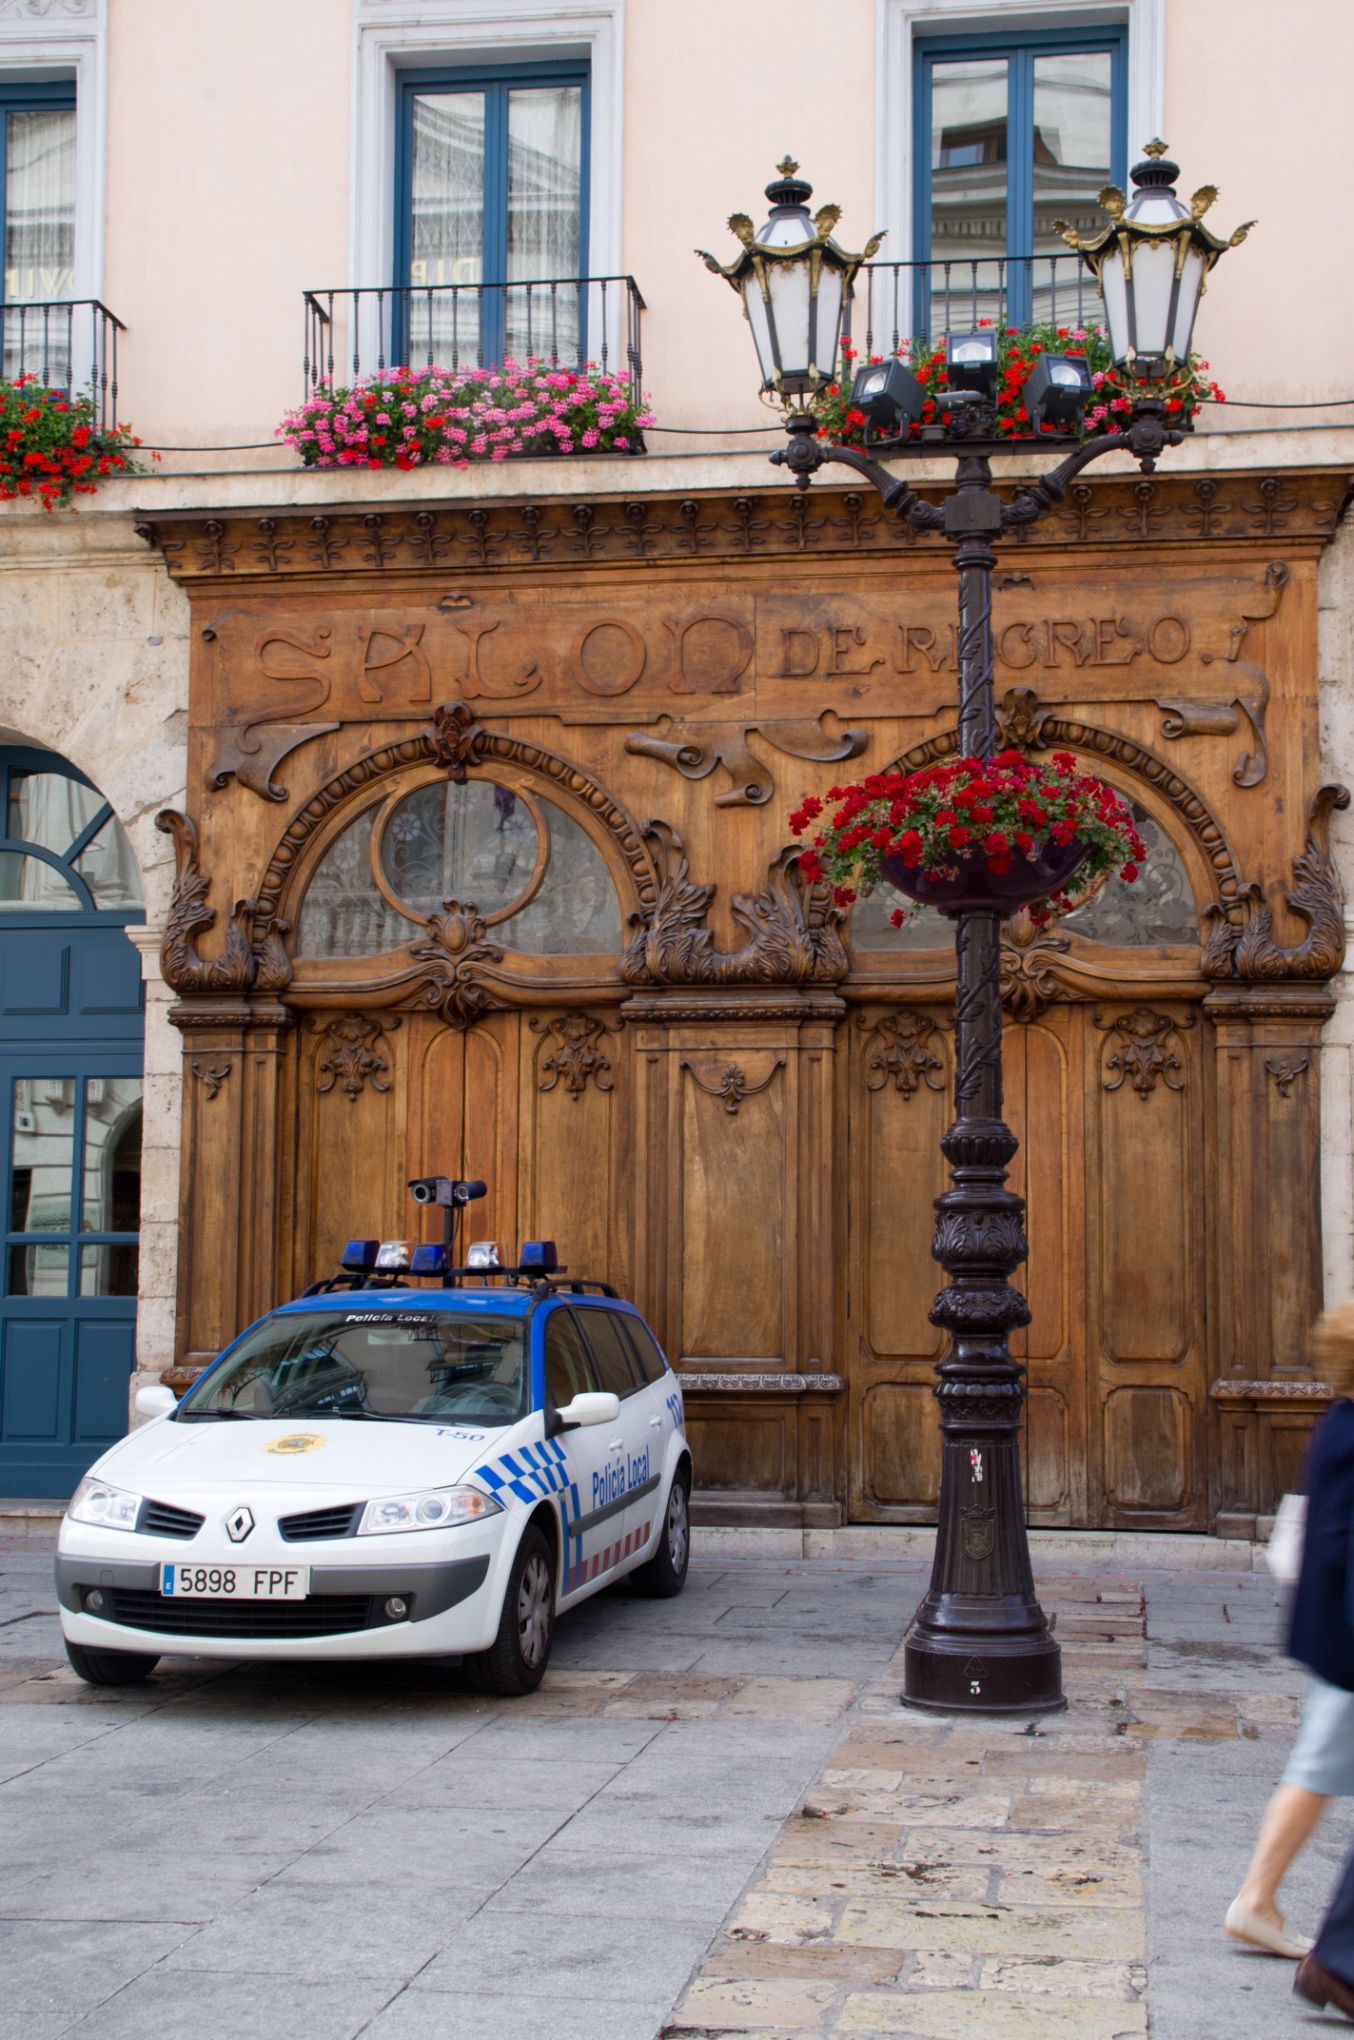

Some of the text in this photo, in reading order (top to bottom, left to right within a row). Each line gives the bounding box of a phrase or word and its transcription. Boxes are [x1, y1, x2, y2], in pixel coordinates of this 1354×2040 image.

[782, 626, 885, 678] DE
[435, 1428, 485, 1442] T-50
[592, 1444, 650, 1511] Policía Local
[180, 1568, 236, 1593] 5898
[254, 1570, 298, 1595] FPF
